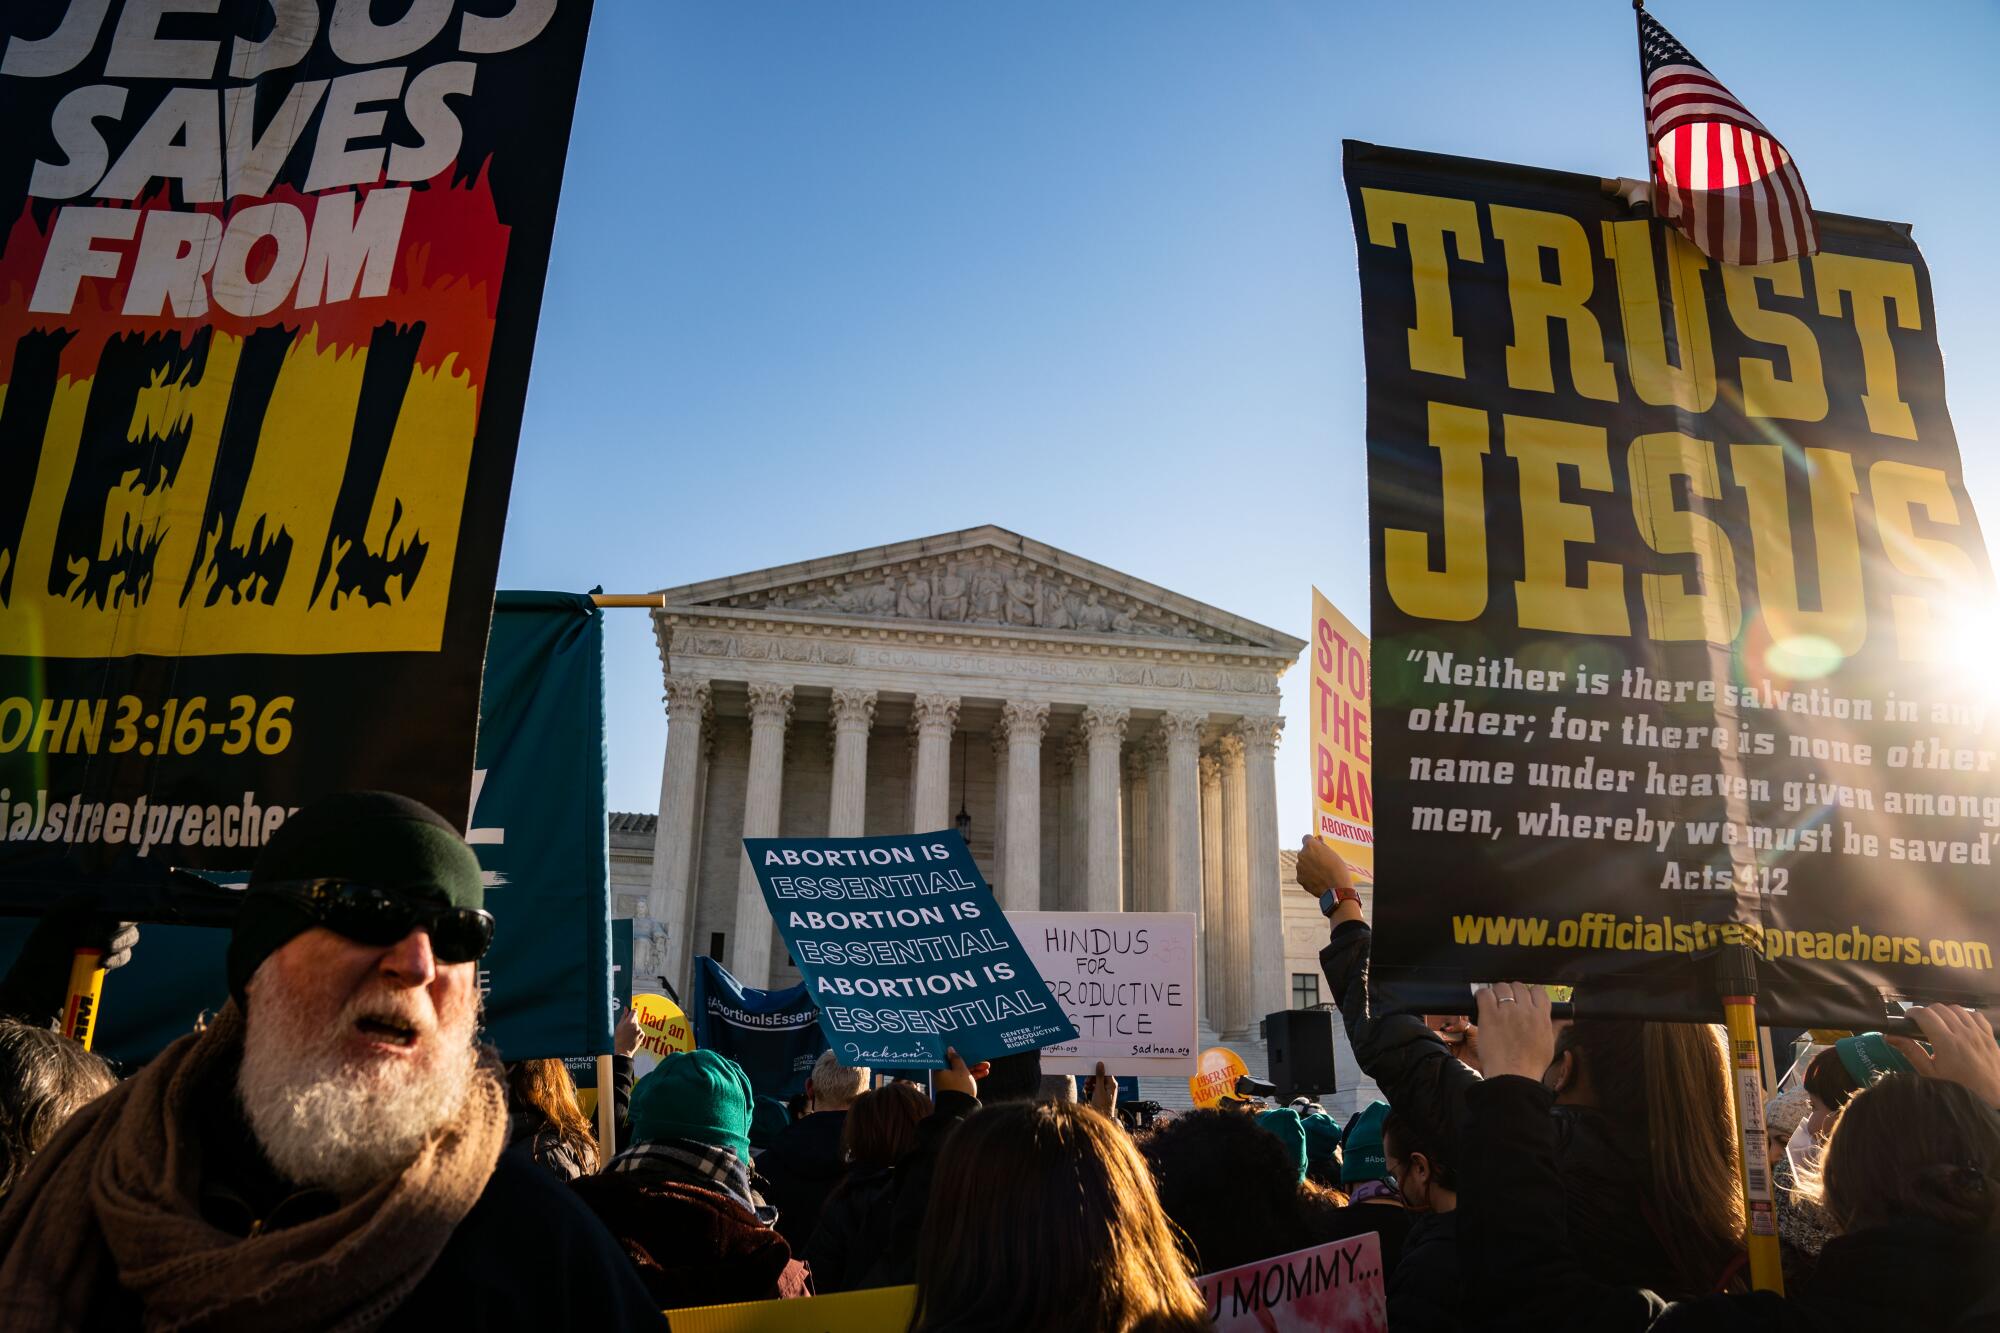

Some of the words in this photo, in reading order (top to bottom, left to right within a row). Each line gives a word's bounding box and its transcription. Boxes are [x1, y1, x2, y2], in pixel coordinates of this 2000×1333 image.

[28, 62, 477, 203] SAVES
[28, 187, 412, 318] FROM
[1359, 186, 1922, 441] TRUST
[1384, 401, 1981, 661] JESUS
[868, 651, 926, 667] EQUAL
[928, 654, 997, 672] JUSTICE
[1004, 659, 1058, 675] UNDER
[1066, 664, 1098, 679] LAW
[1317, 617, 1371, 701] STO
[1576, 664, 1609, 695] is
[1621, 667, 1715, 702] there
[1724, 679, 1872, 721] salvation
[1884, 691, 1919, 722] in
[1930, 701, 1986, 734] any
[109, 695, 295, 756] 3:16-36
[1317, 676, 1370, 765] THE
[1408, 700, 1536, 743] other;
[1549, 706, 1609, 742] for
[1622, 714, 1729, 751] there
[1737, 722, 1775, 755] is
[1789, 734, 1872, 766] none
[1886, 737, 1997, 772] other
[1409, 756, 1515, 785] name
[1528, 756, 1635, 792] under
[1645, 762, 1770, 802] heaven
[1783, 773, 1874, 812] given
[1884, 790, 2000, 827] among
[1411, 806, 1502, 840] men,
[1517, 803, 1675, 852] whereby
[1685, 821, 1738, 846] we
[1747, 823, 1832, 853] must
[1843, 821, 1878, 857] be
[764, 847, 915, 866] ABORTION
[923, 843, 950, 862] IS
[770, 869, 976, 900] ESSENTIAL
[1660, 861, 1733, 891] Acts
[1739, 864, 1788, 896] 4:12
[789, 906, 945, 930] ABORTION
[951, 901, 981, 921] IS
[796, 928, 1009, 966] ESSENTIAL
[1046, 928, 1149, 954] HINDUS
[818, 971, 978, 997] ABORTION
[984, 962, 1015, 984] IS
[1076, 957, 1114, 974] FOR
[640, 1006, 667, 1032] had
[668, 1023, 685, 1041] an
[826, 990, 1046, 1034] ESSENTIAL
[1000, 1027, 1031, 1039] CENTER
[1003, 1025, 1061, 1044] REPRODUCTIVE
[1006, 1038, 1036, 1049] RIGHTS
[844, 1042, 933, 1061] Jackson
[1196, 1064, 1237, 1088] LIBERATE
[1232, 1243, 1379, 1318] MOMMY...
